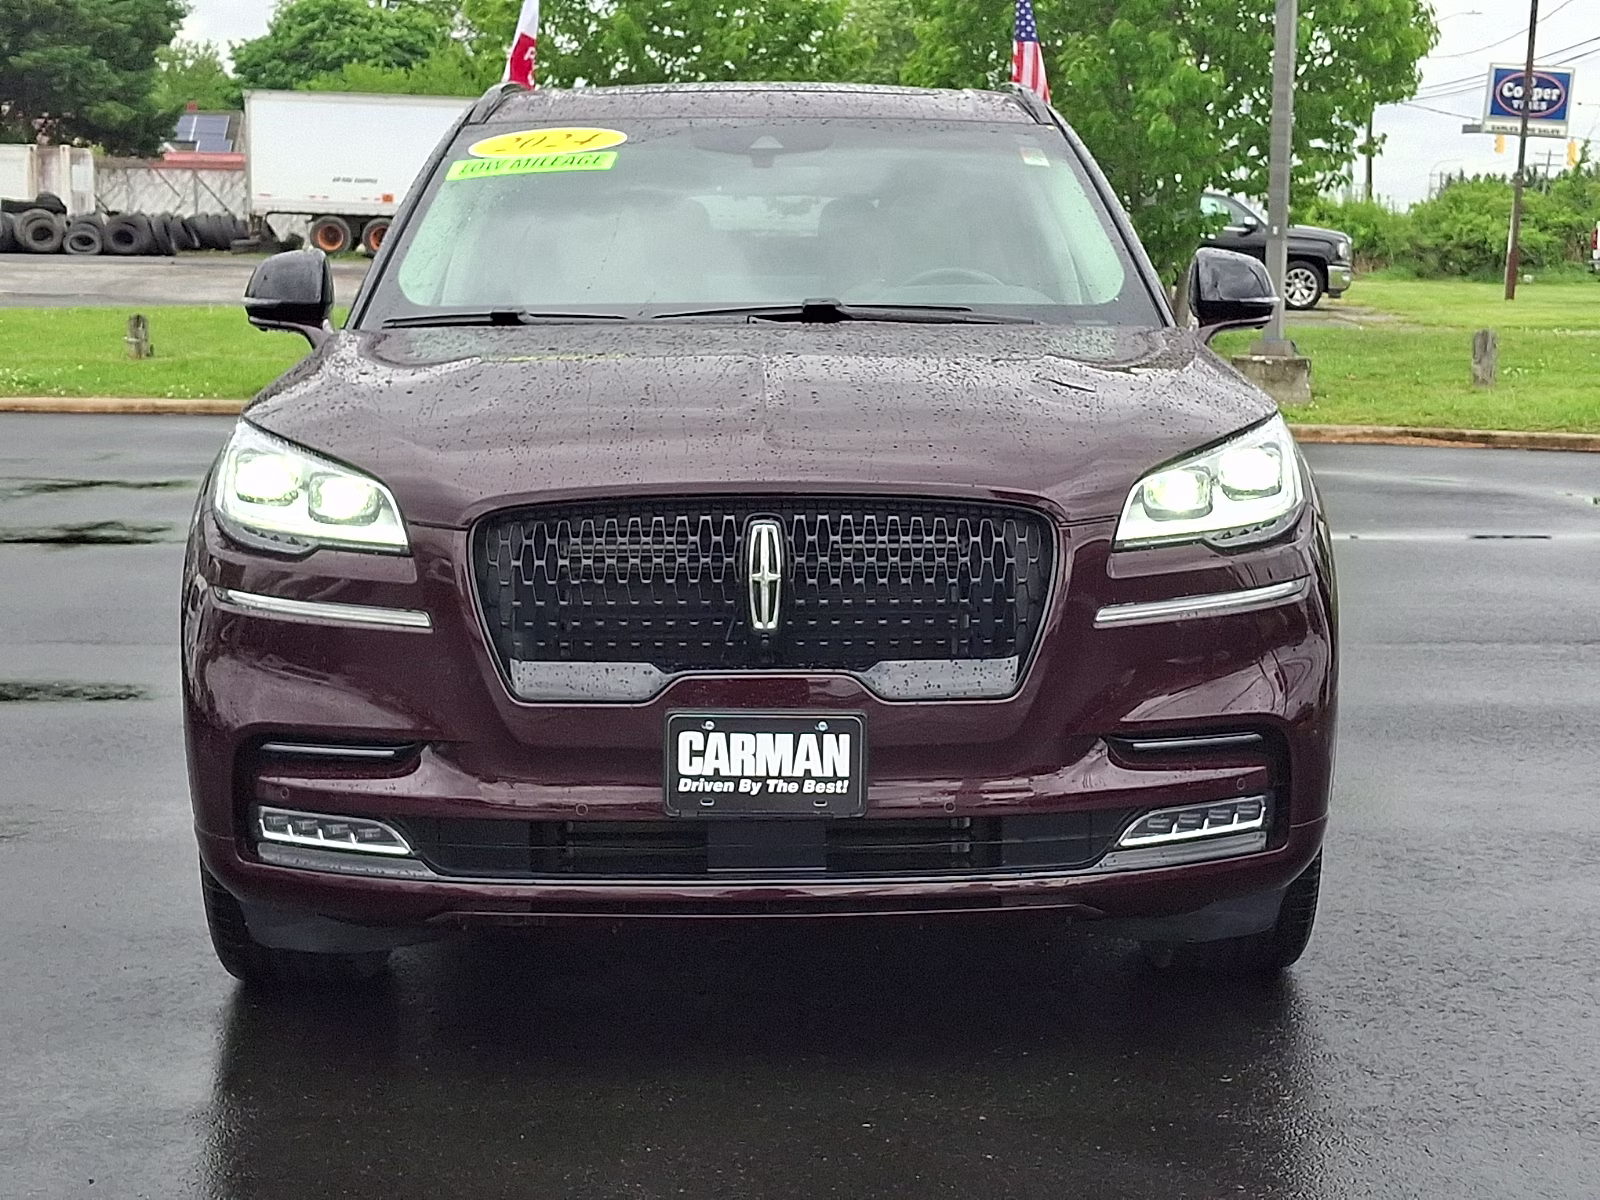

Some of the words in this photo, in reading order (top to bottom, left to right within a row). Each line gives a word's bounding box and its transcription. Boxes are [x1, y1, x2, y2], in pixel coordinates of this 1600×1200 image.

[1502, 82, 1560, 101] Coper
[459, 159, 506, 176] LOW
[509, 154, 604, 170] MILEAGE
[677, 730, 851, 777] CARMAN
[677, 778, 735, 793] Driven
[738, 778, 763, 796] By
[766, 779, 799, 793] The
[802, 779, 849, 794] Best!
